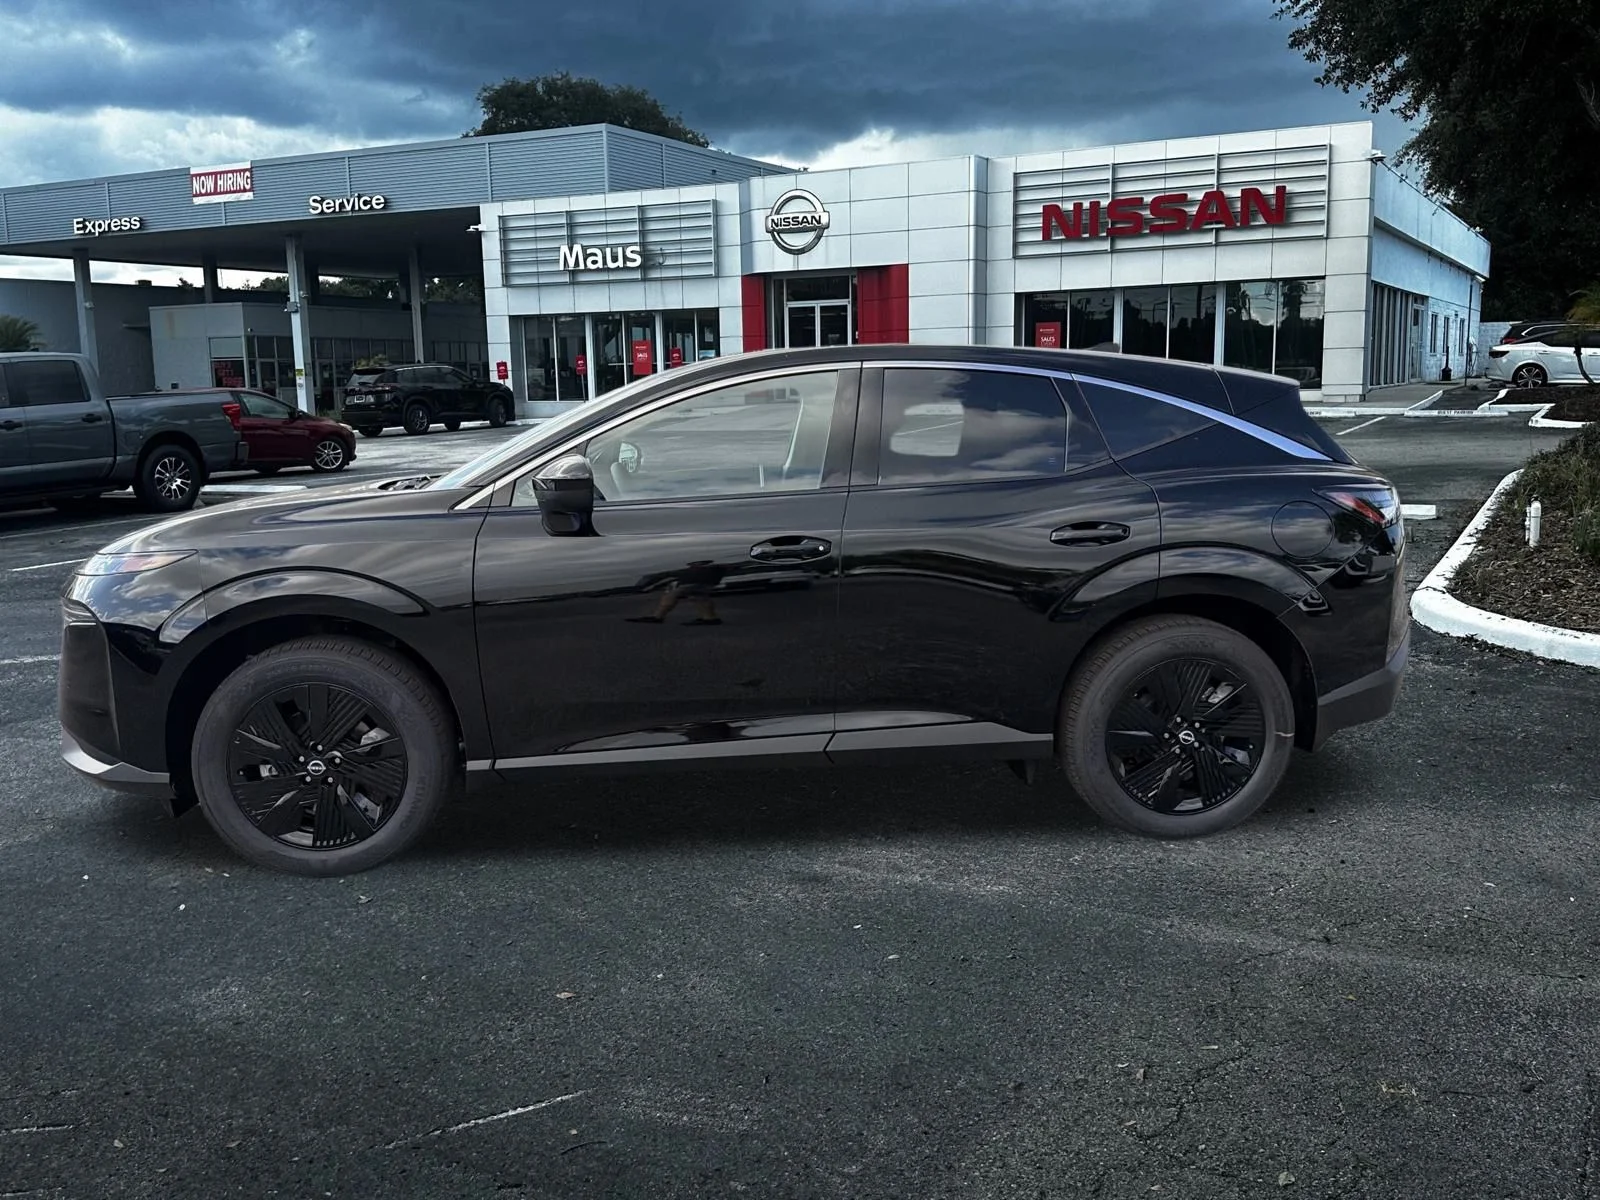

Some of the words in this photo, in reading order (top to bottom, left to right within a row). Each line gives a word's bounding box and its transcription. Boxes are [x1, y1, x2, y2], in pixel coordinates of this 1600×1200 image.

[192, 175, 216, 195] NOW
[217, 171, 251, 193] HIRING
[309, 193, 385, 214] Service
[1041, 185, 1287, 241] NISSAN
[73, 216, 141, 236] Express
[770, 215, 821, 228] NISSAN
[560, 243, 642, 270] Maus
